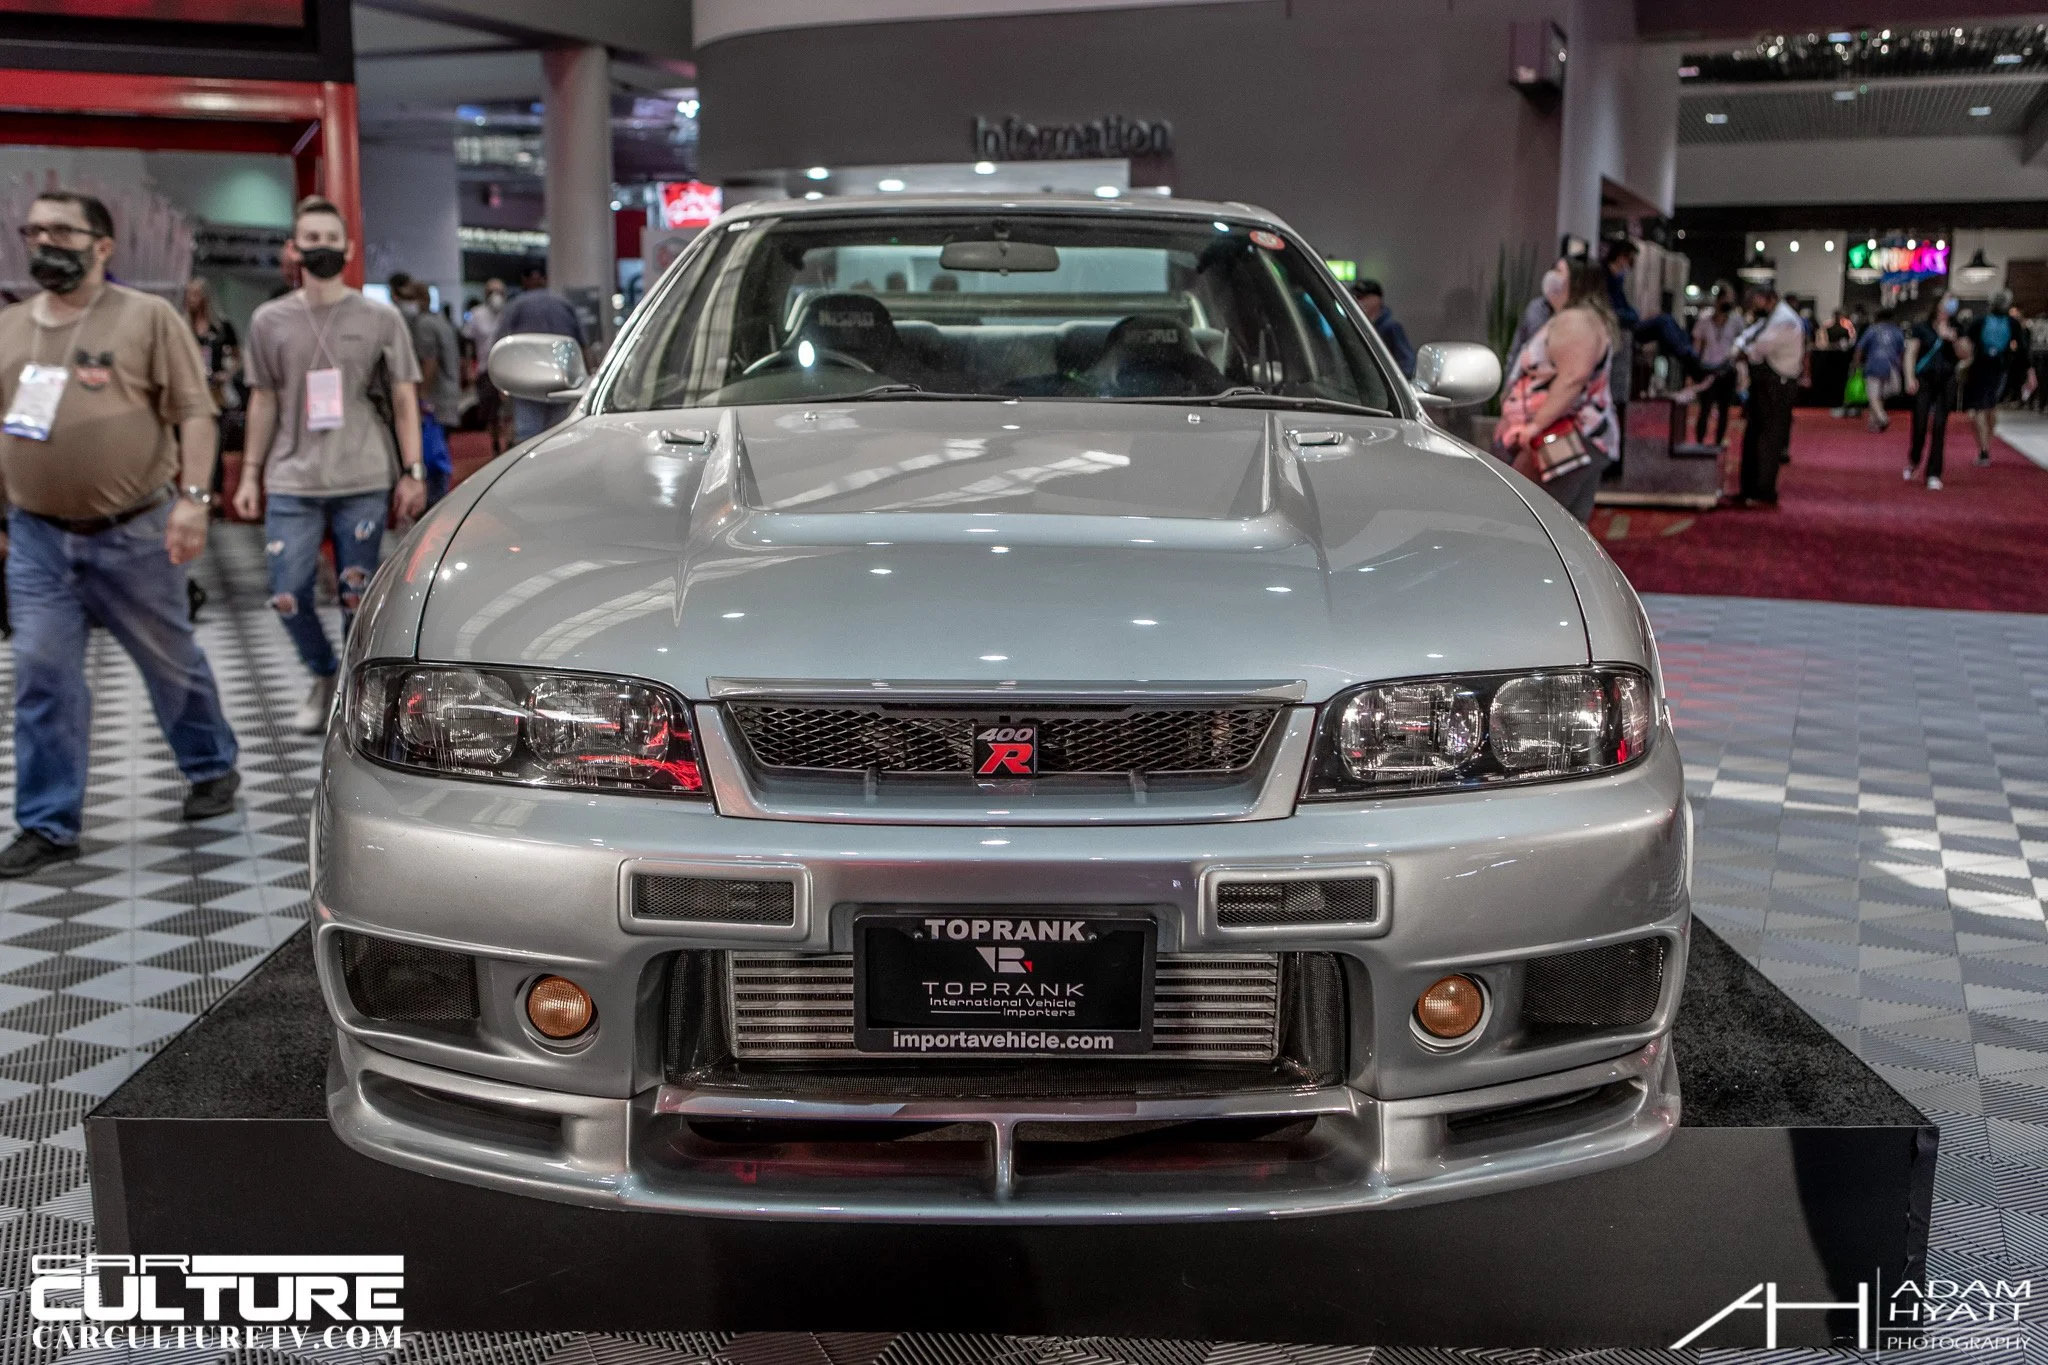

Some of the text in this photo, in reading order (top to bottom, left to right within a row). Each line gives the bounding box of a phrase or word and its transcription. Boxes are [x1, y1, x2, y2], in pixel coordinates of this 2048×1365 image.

[971, 114, 1173, 156] Information
[976, 728, 1033, 741] 400
[977, 743, 1034, 774] R
[925, 919, 1086, 941] TOPRANK
[922, 982, 1085, 997] TOPRANK
[929, 997, 1076, 1008] International Vehicle
[1003, 1008, 1076, 1018] Importers
[893, 1031, 1114, 1051] importavehicle.com
